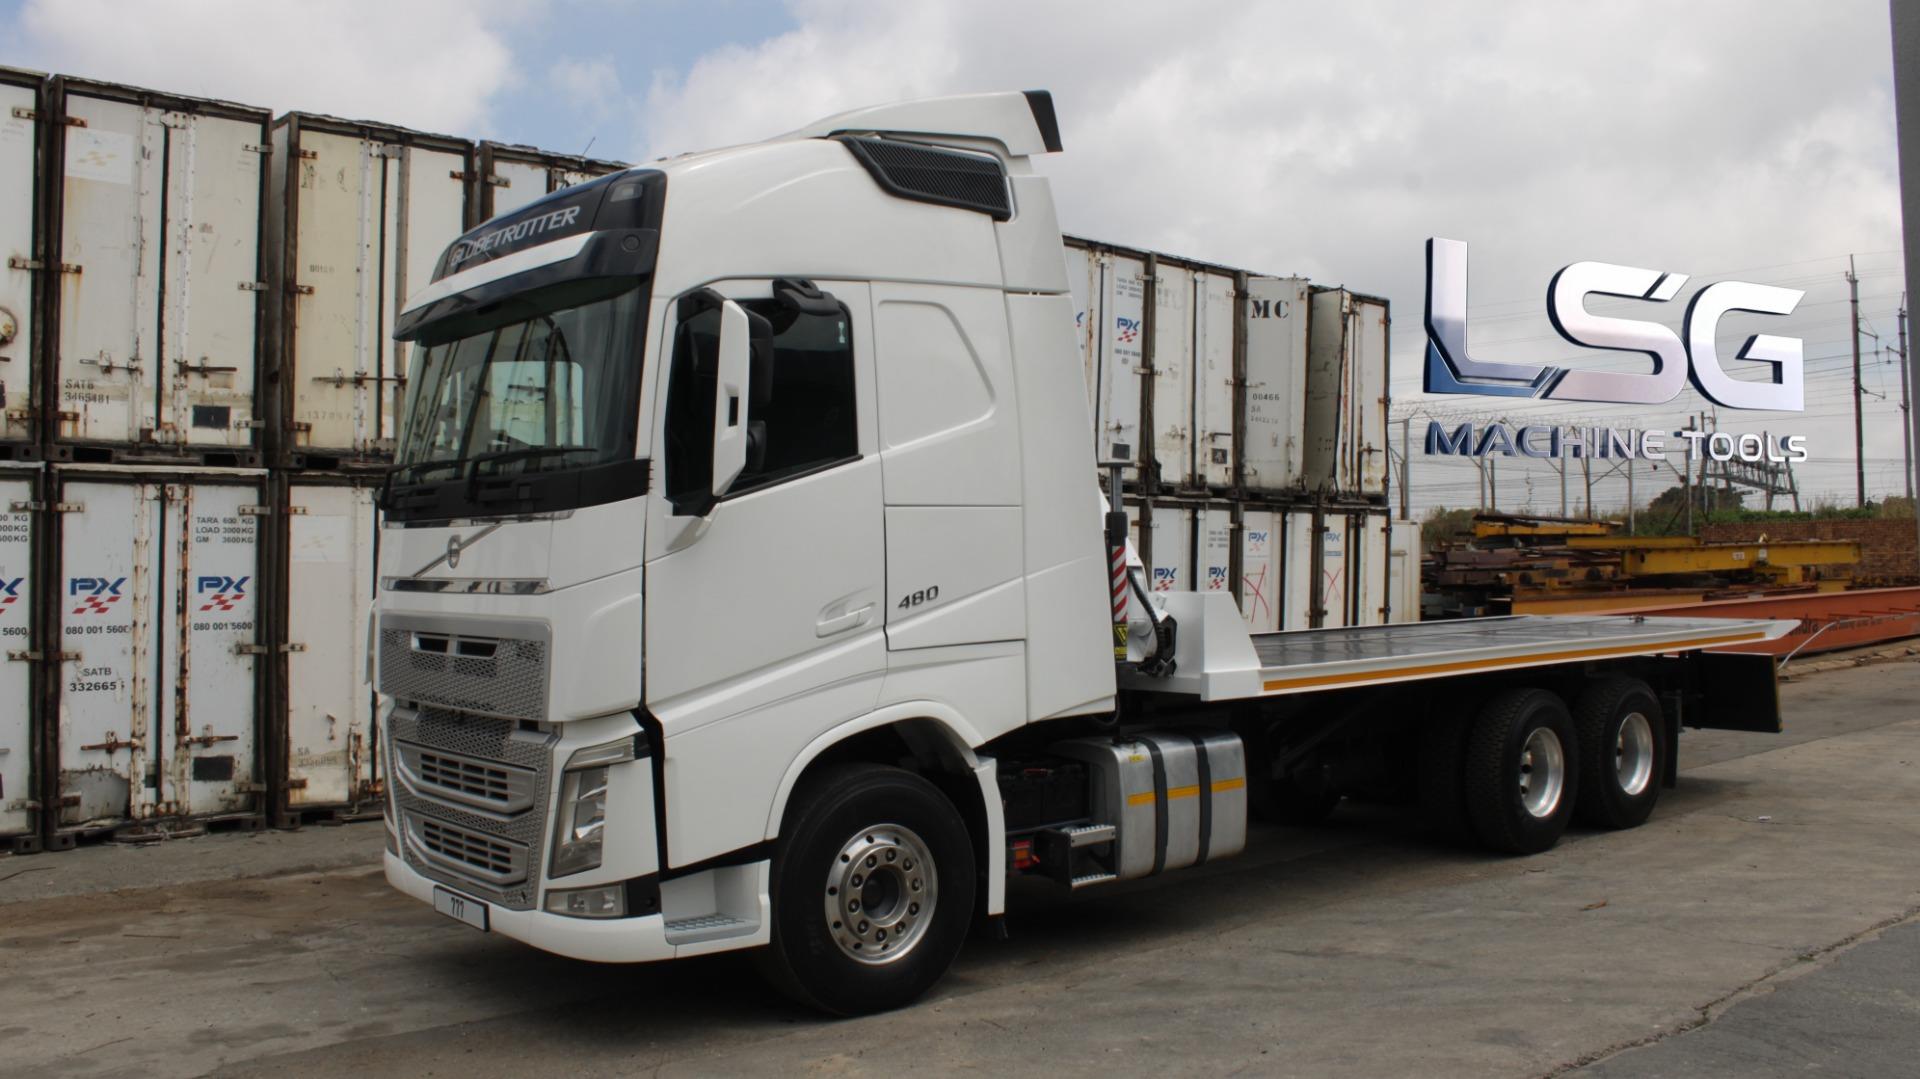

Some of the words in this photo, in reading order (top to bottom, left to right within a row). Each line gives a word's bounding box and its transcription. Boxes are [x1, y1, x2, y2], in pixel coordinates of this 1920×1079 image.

[450, 206, 580, 267] GLOBETROTTER
[1251, 299, 1289, 319] MC
[196, 516, 219, 524] TARA
[241, 517, 254, 525] KG
[196, 526, 220, 534] LOAD
[1154, 567, 1177, 579] PX
[1208, 566, 1227, 578] PX
[70, 577, 127, 596] PX
[198, 576, 251, 593] PX
[897, 585, 939, 609] 480
[3, 626, 27, 636] 5600
[65, 626, 83, 635] 080
[86, 625, 103, 634] 001
[193, 622, 210, 631] 080
[212, 622, 228, 630] 001
[231, 621, 253, 630] 5600
[83, 667, 112, 677] SATB
[451, 897, 464, 918] 777
